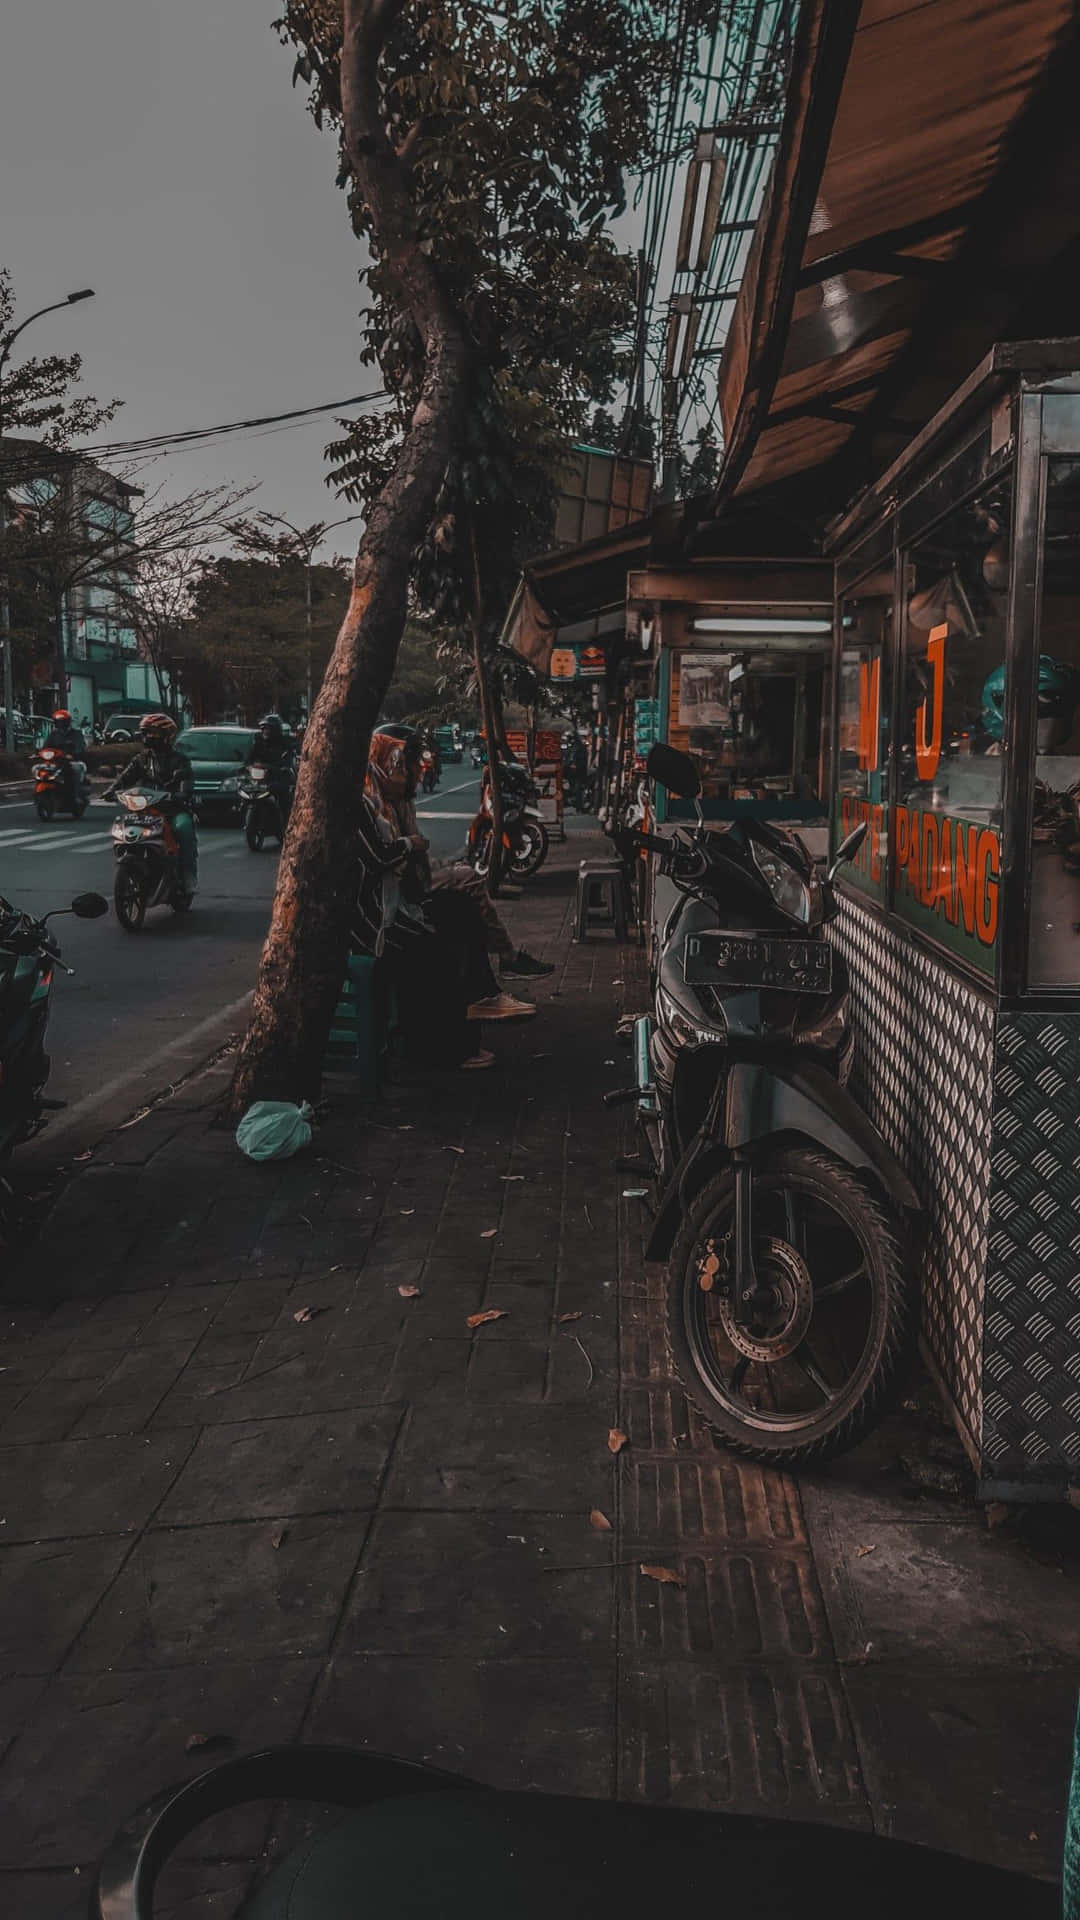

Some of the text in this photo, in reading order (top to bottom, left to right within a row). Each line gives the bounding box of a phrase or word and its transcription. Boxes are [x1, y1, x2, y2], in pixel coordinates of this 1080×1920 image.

[915, 622, 948, 781] J
[895, 806, 999, 945] PADANG
[689, 938, 701, 958] D
